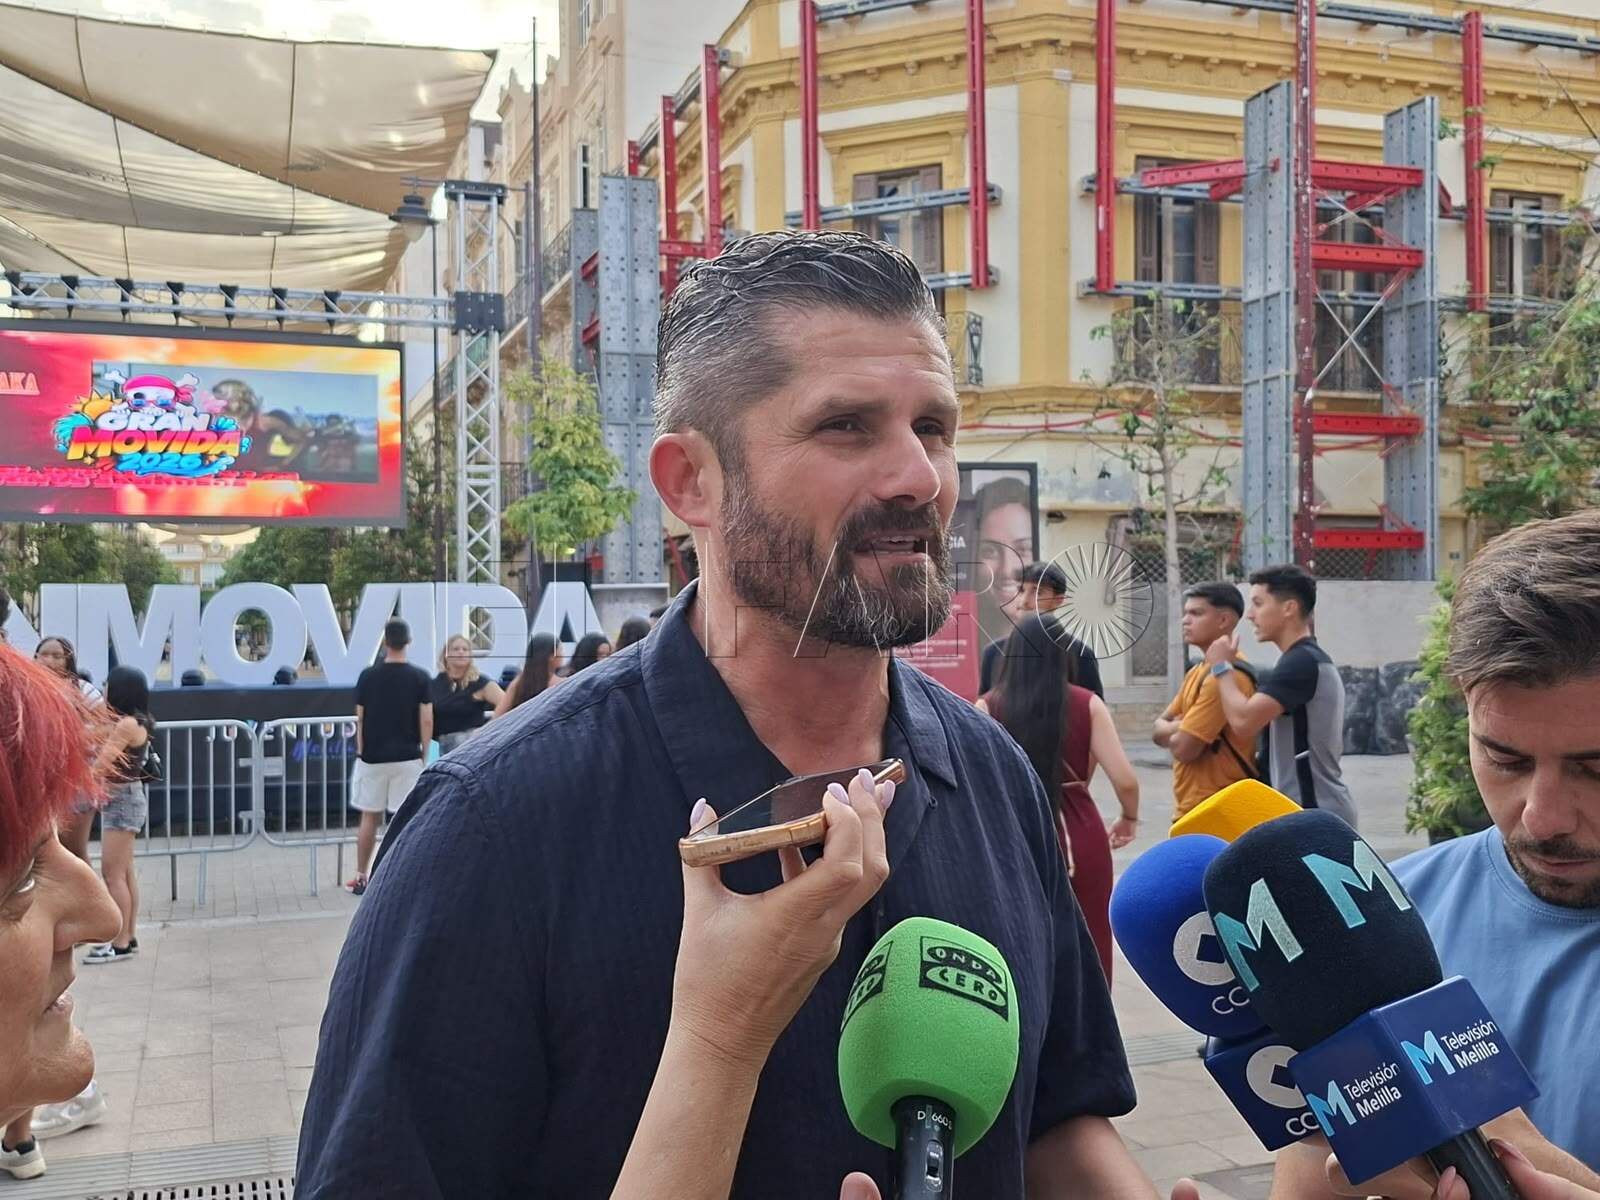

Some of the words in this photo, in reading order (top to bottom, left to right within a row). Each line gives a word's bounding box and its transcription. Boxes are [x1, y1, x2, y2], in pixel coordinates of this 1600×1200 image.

[96, 411, 210, 431] GRAN
[67, 426, 240, 460] MOVIDA
[934, 947, 1001, 983] ONDA
[938, 967, 999, 1001] CERO
[1441, 1019, 1498, 1053] Televisión
[1454, 1040, 1500, 1069] Melilla
[1343, 1061, 1400, 1101] Televisión
[1356, 1084, 1402, 1119] Melilla
